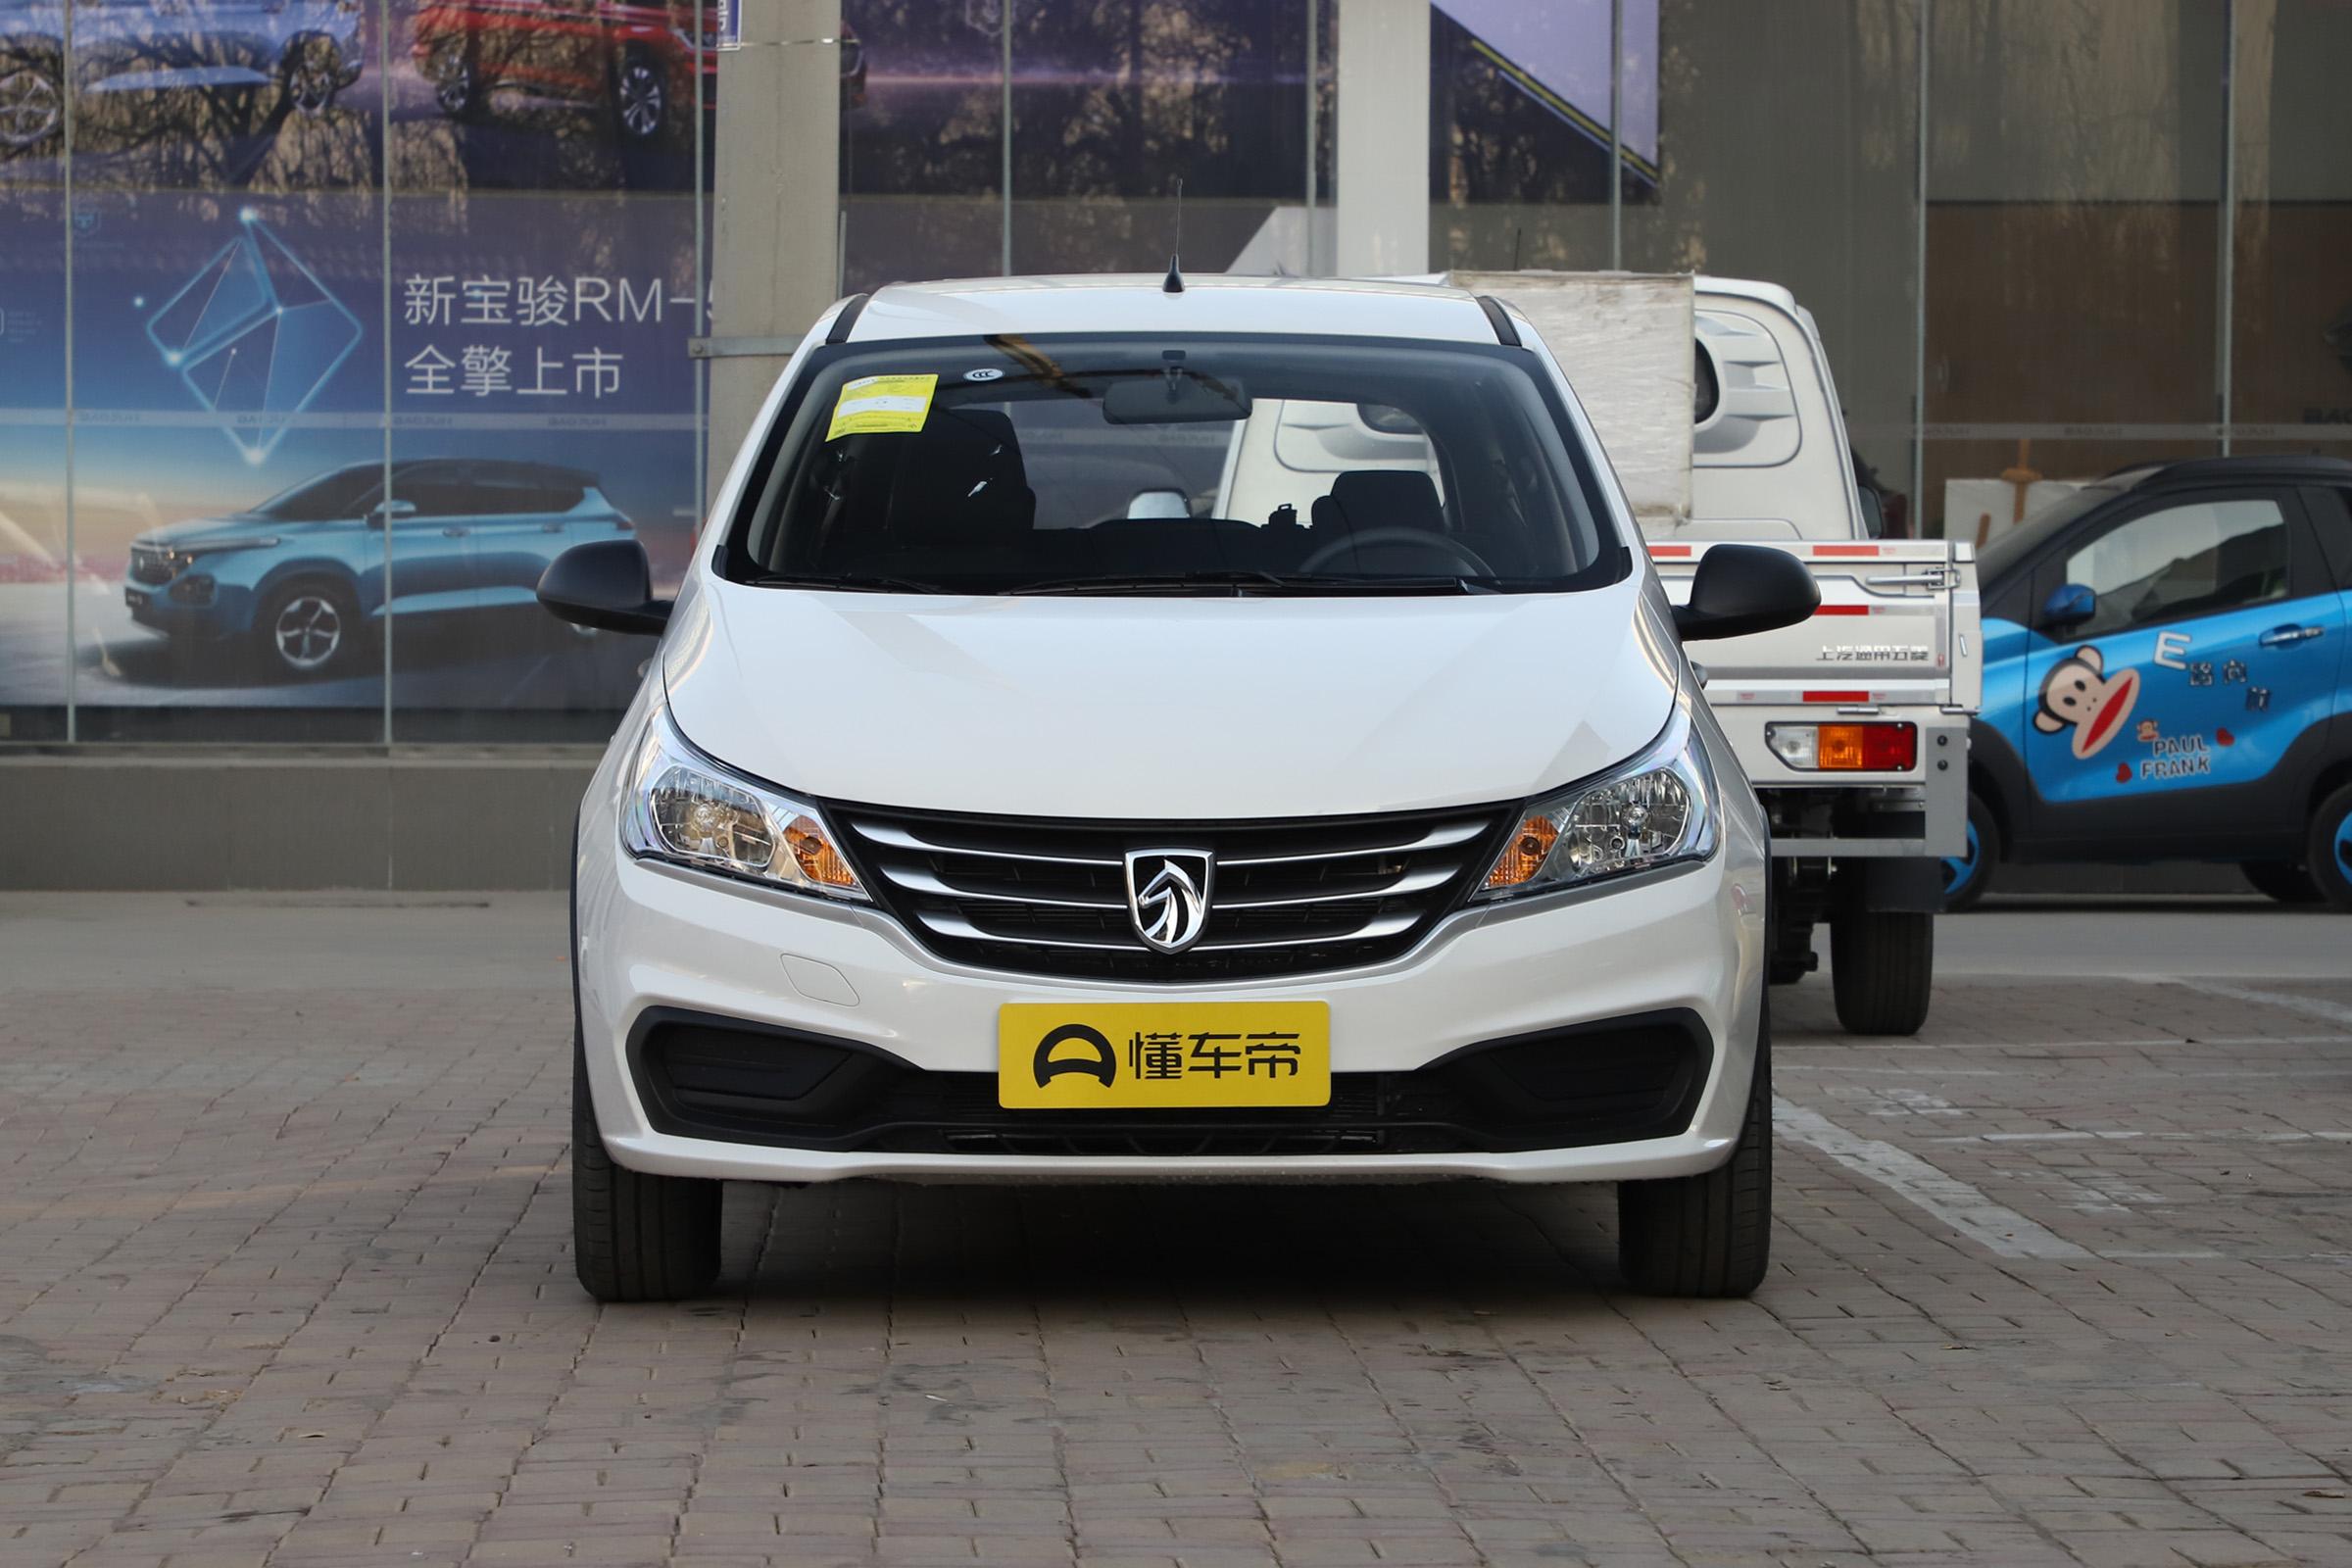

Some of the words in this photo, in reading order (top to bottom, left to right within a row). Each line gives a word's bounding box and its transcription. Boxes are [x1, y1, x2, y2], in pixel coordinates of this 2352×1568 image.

[404, 273, 712, 326] 新宝骏RM-
[404, 345, 623, 399] 全擎上市
[1816, 645, 1929, 661] 上汽通用五菱
[2153, 734, 2209, 757] PAUL
[2140, 756, 2211, 779] FRANK
[1129, 1031, 1301, 1080] 懂车帝
